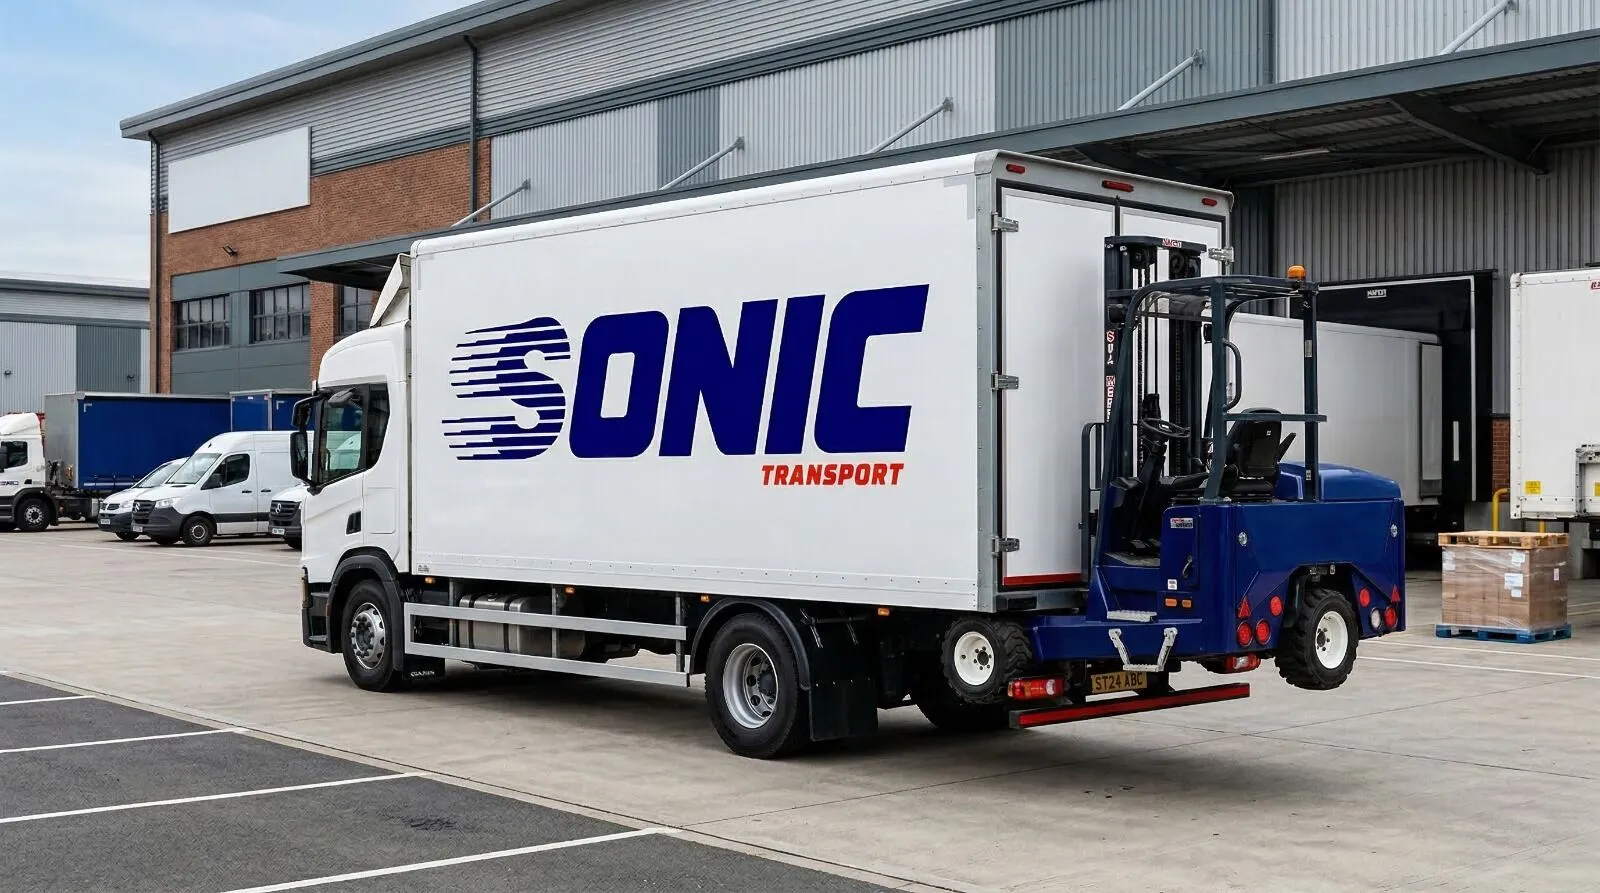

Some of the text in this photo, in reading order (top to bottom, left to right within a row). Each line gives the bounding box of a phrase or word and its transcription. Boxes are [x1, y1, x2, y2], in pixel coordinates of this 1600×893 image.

[442, 284, 929, 460] SONIC
[762, 463, 904, 486] TRANSPORT
[1095, 672, 1143, 690] ST24 ABC
